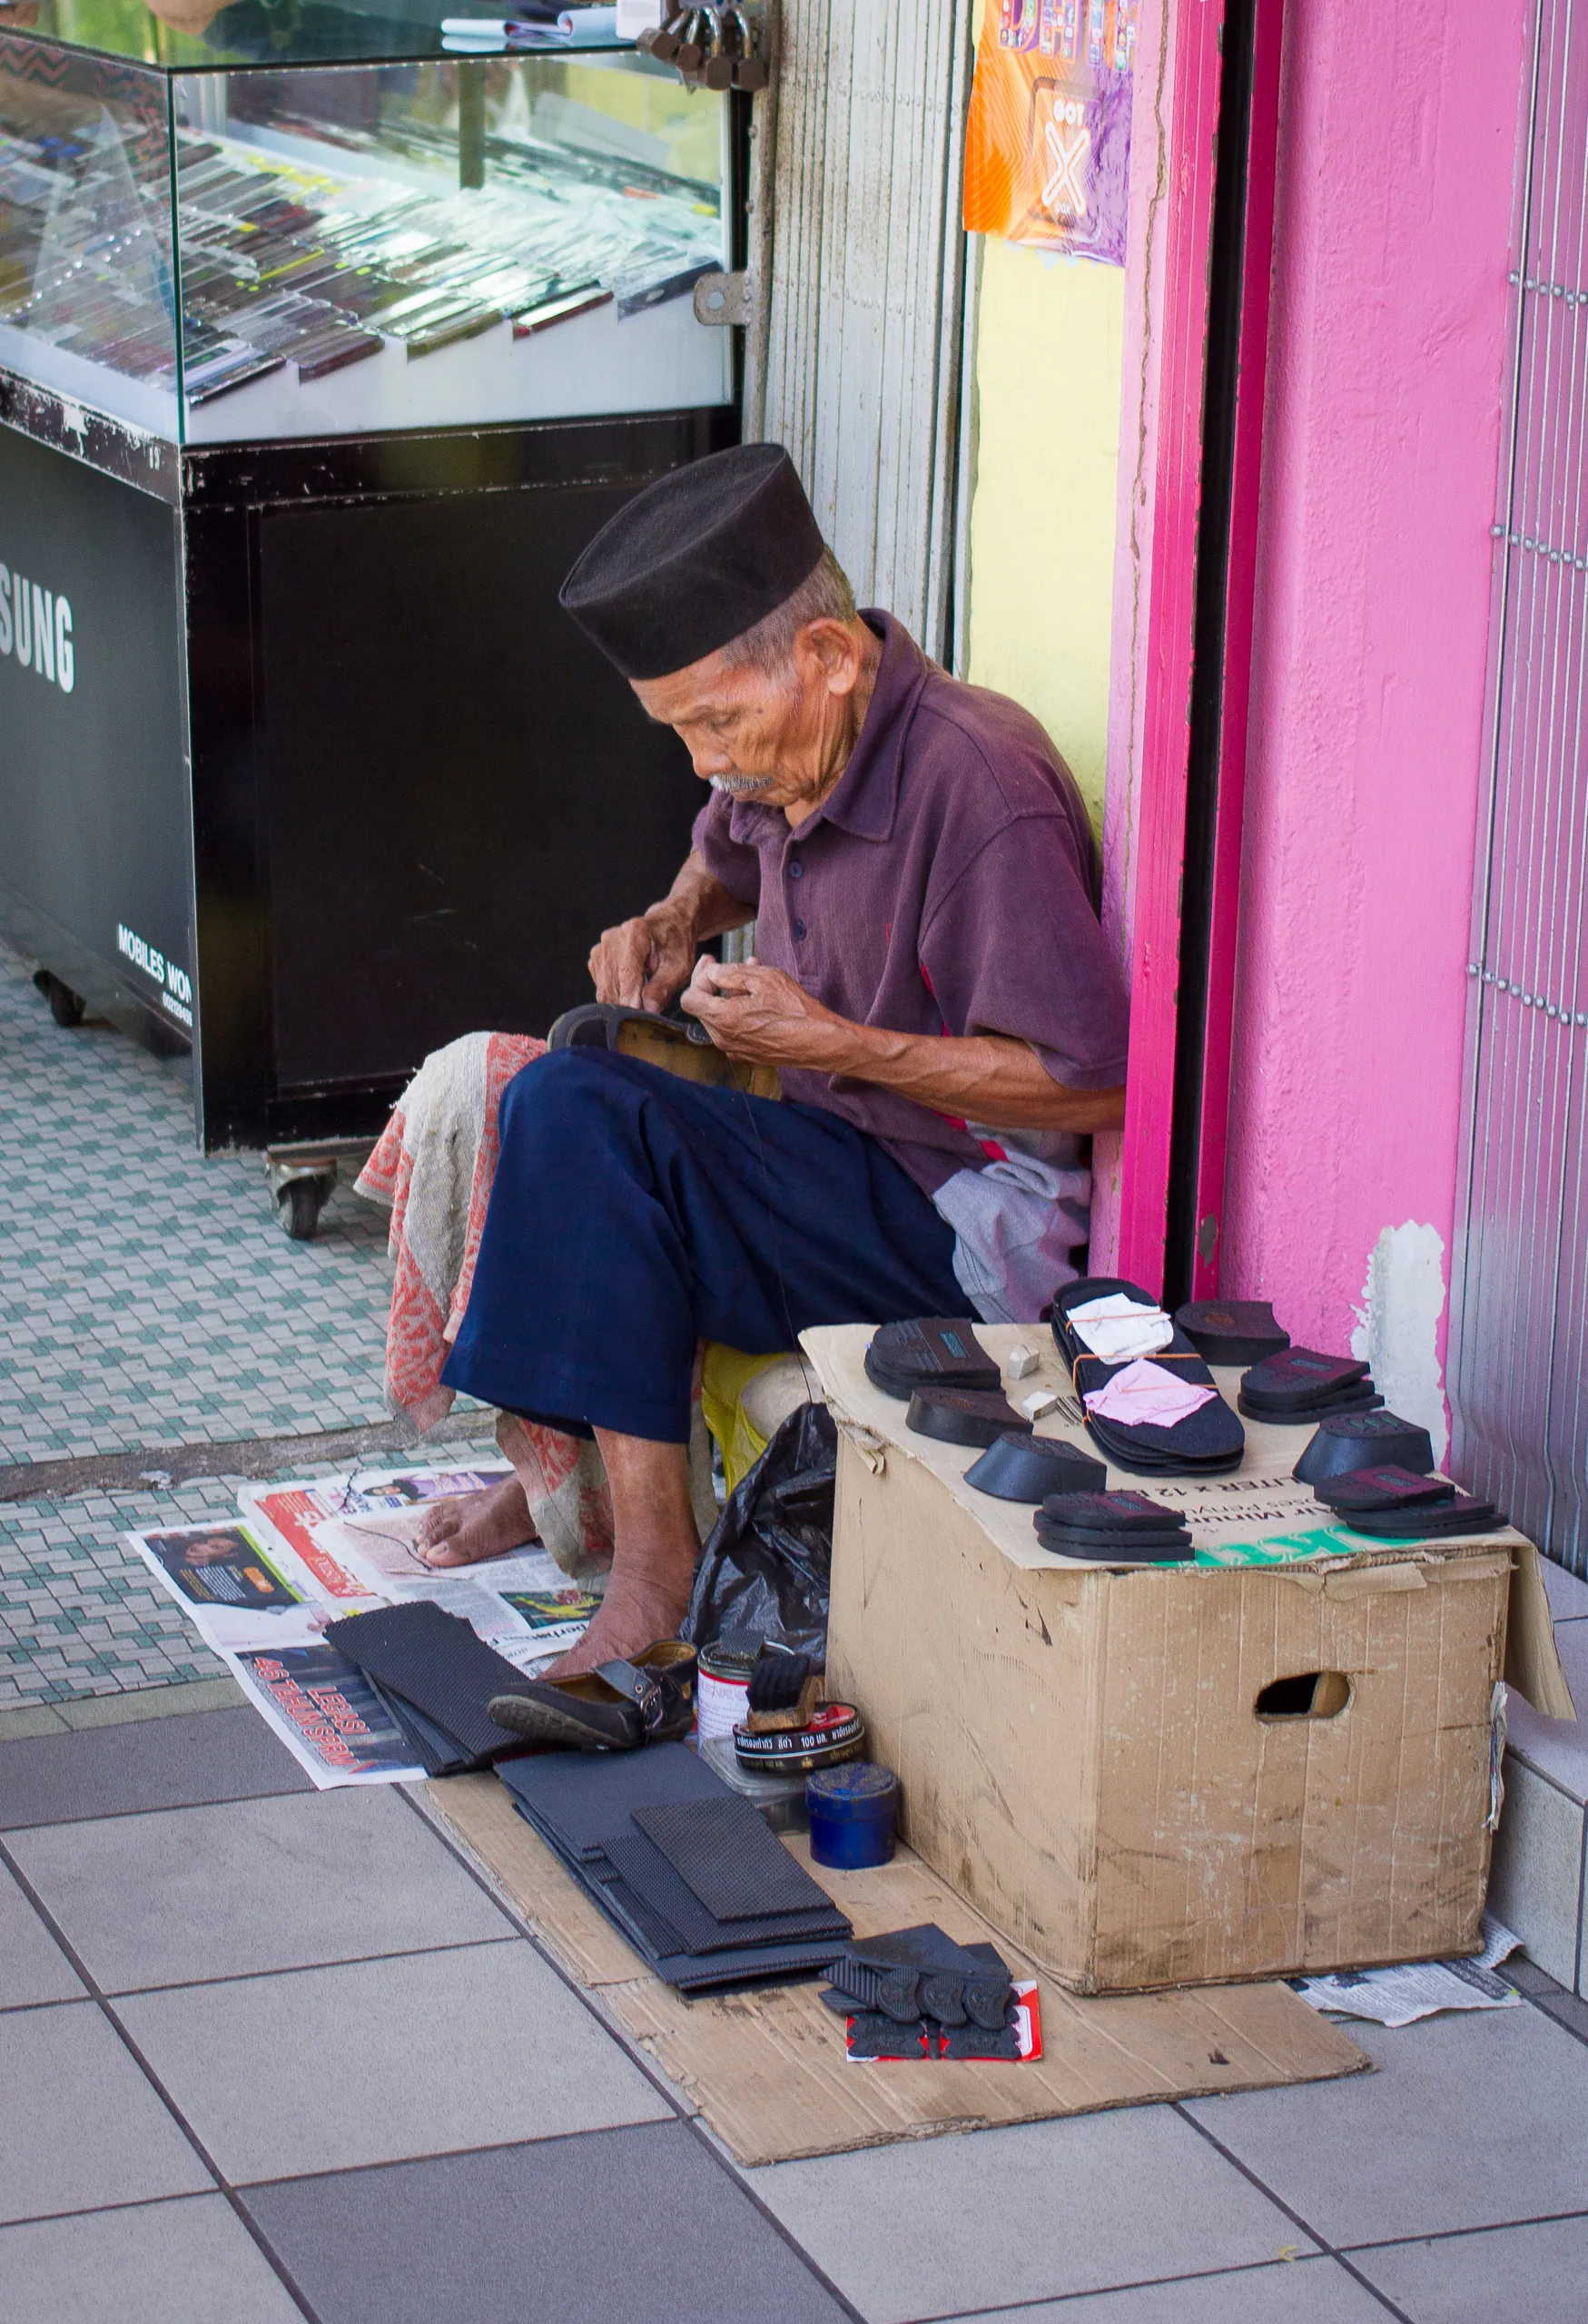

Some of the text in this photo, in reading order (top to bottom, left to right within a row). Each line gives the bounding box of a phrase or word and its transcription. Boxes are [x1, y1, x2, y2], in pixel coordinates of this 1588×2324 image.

[1053, 99, 1085, 126] GOT
[1041, 121, 1090, 216] X
[0, 561, 74, 694] SUNG
[118, 923, 165, 984] MOBILES
[1154, 1486, 1188, 1498] 12
[1217, 1476, 1302, 1493] LITER
[253, 1657, 290, 1680] 46
[267, 1679, 328, 1728] TAHUN
[307, 1685, 371, 1735] LEGASI
[303, 1726, 360, 1767] SPRM
[801, 1735, 815, 1748] 100
